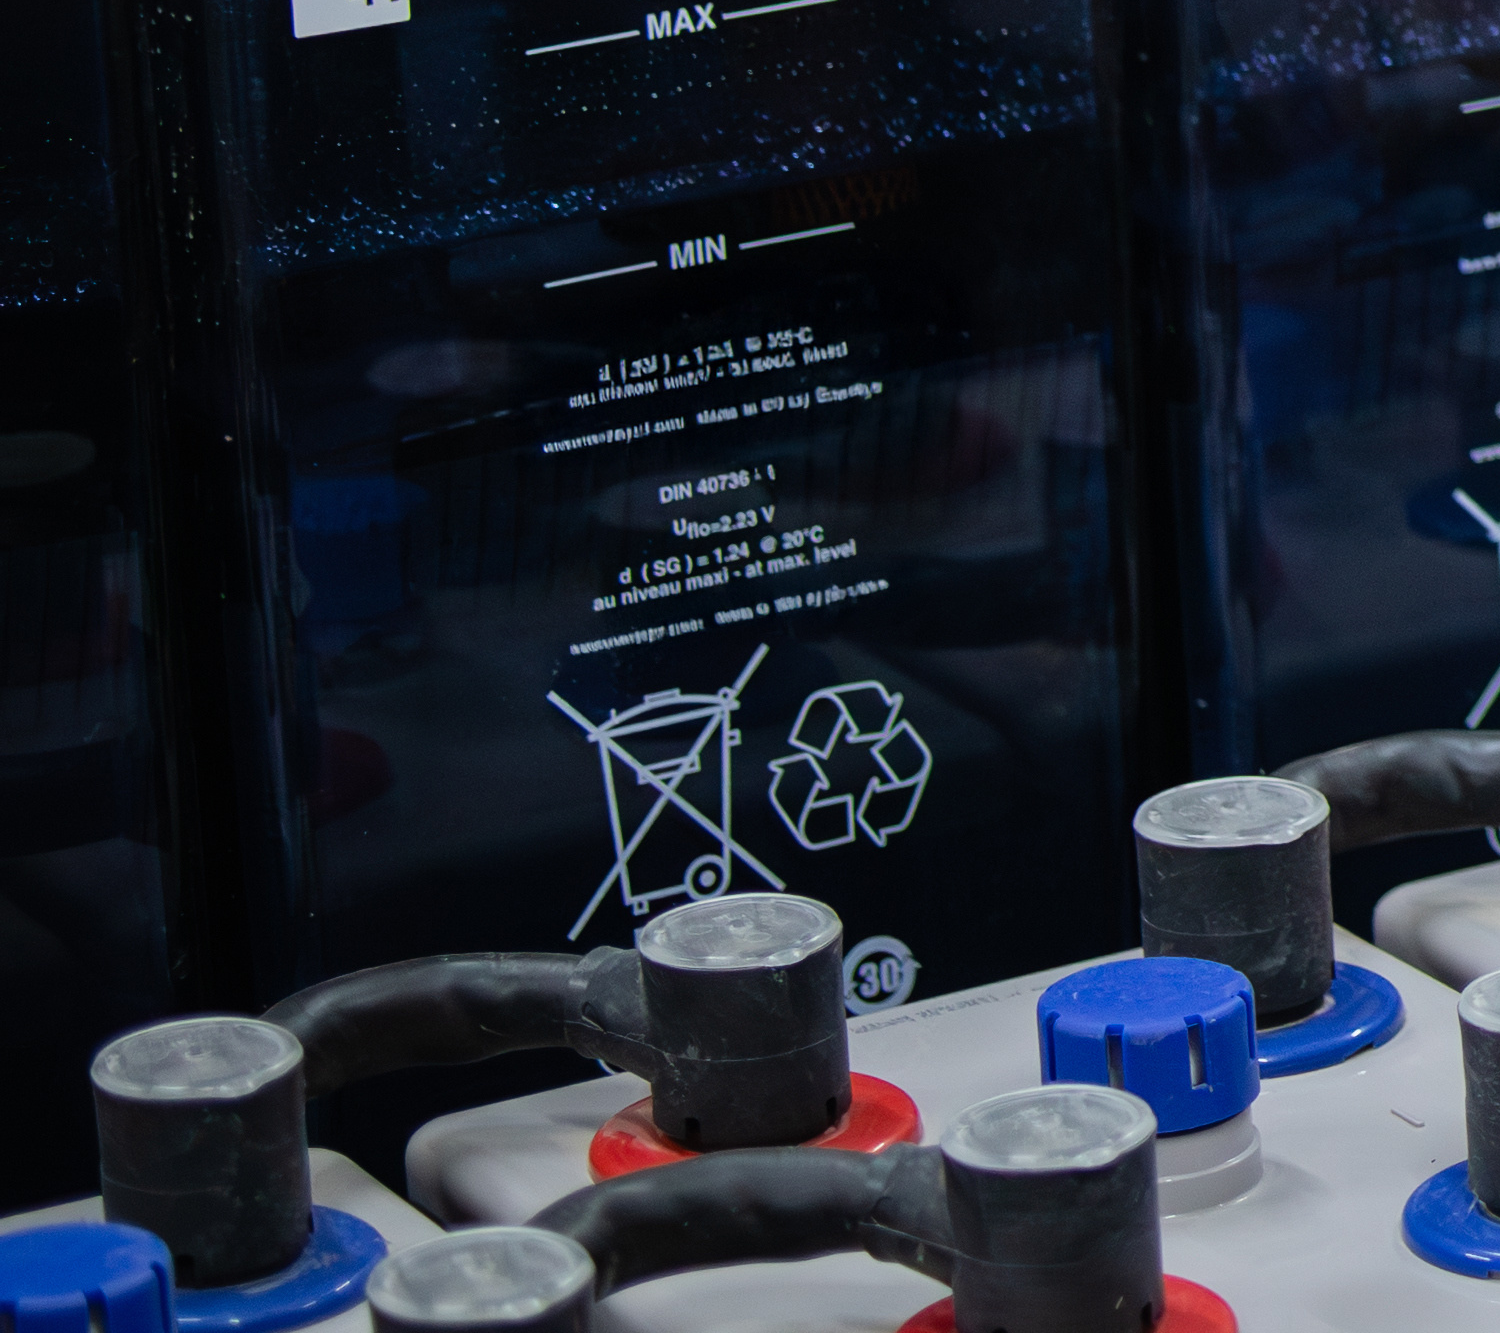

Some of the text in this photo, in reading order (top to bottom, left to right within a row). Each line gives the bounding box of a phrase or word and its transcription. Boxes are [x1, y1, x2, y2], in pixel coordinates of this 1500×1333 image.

[645, 2, 717, 41] MAX
[669, 234, 727, 271] MIN
[659, 482, 692, 504] DIN
[697, 469, 751, 496] 40736
[760, 504, 776, 524] V
[592, 594, 617, 612] au
[620, 580, 682, 606] niveau
[685, 568, 730, 593] maxi
[744, 561, 764, 580] at
[814, 538, 857, 566] level
[618, 565, 633, 585] d
[652, 555, 682, 579] SG
[858, 959, 900, 999] 30
